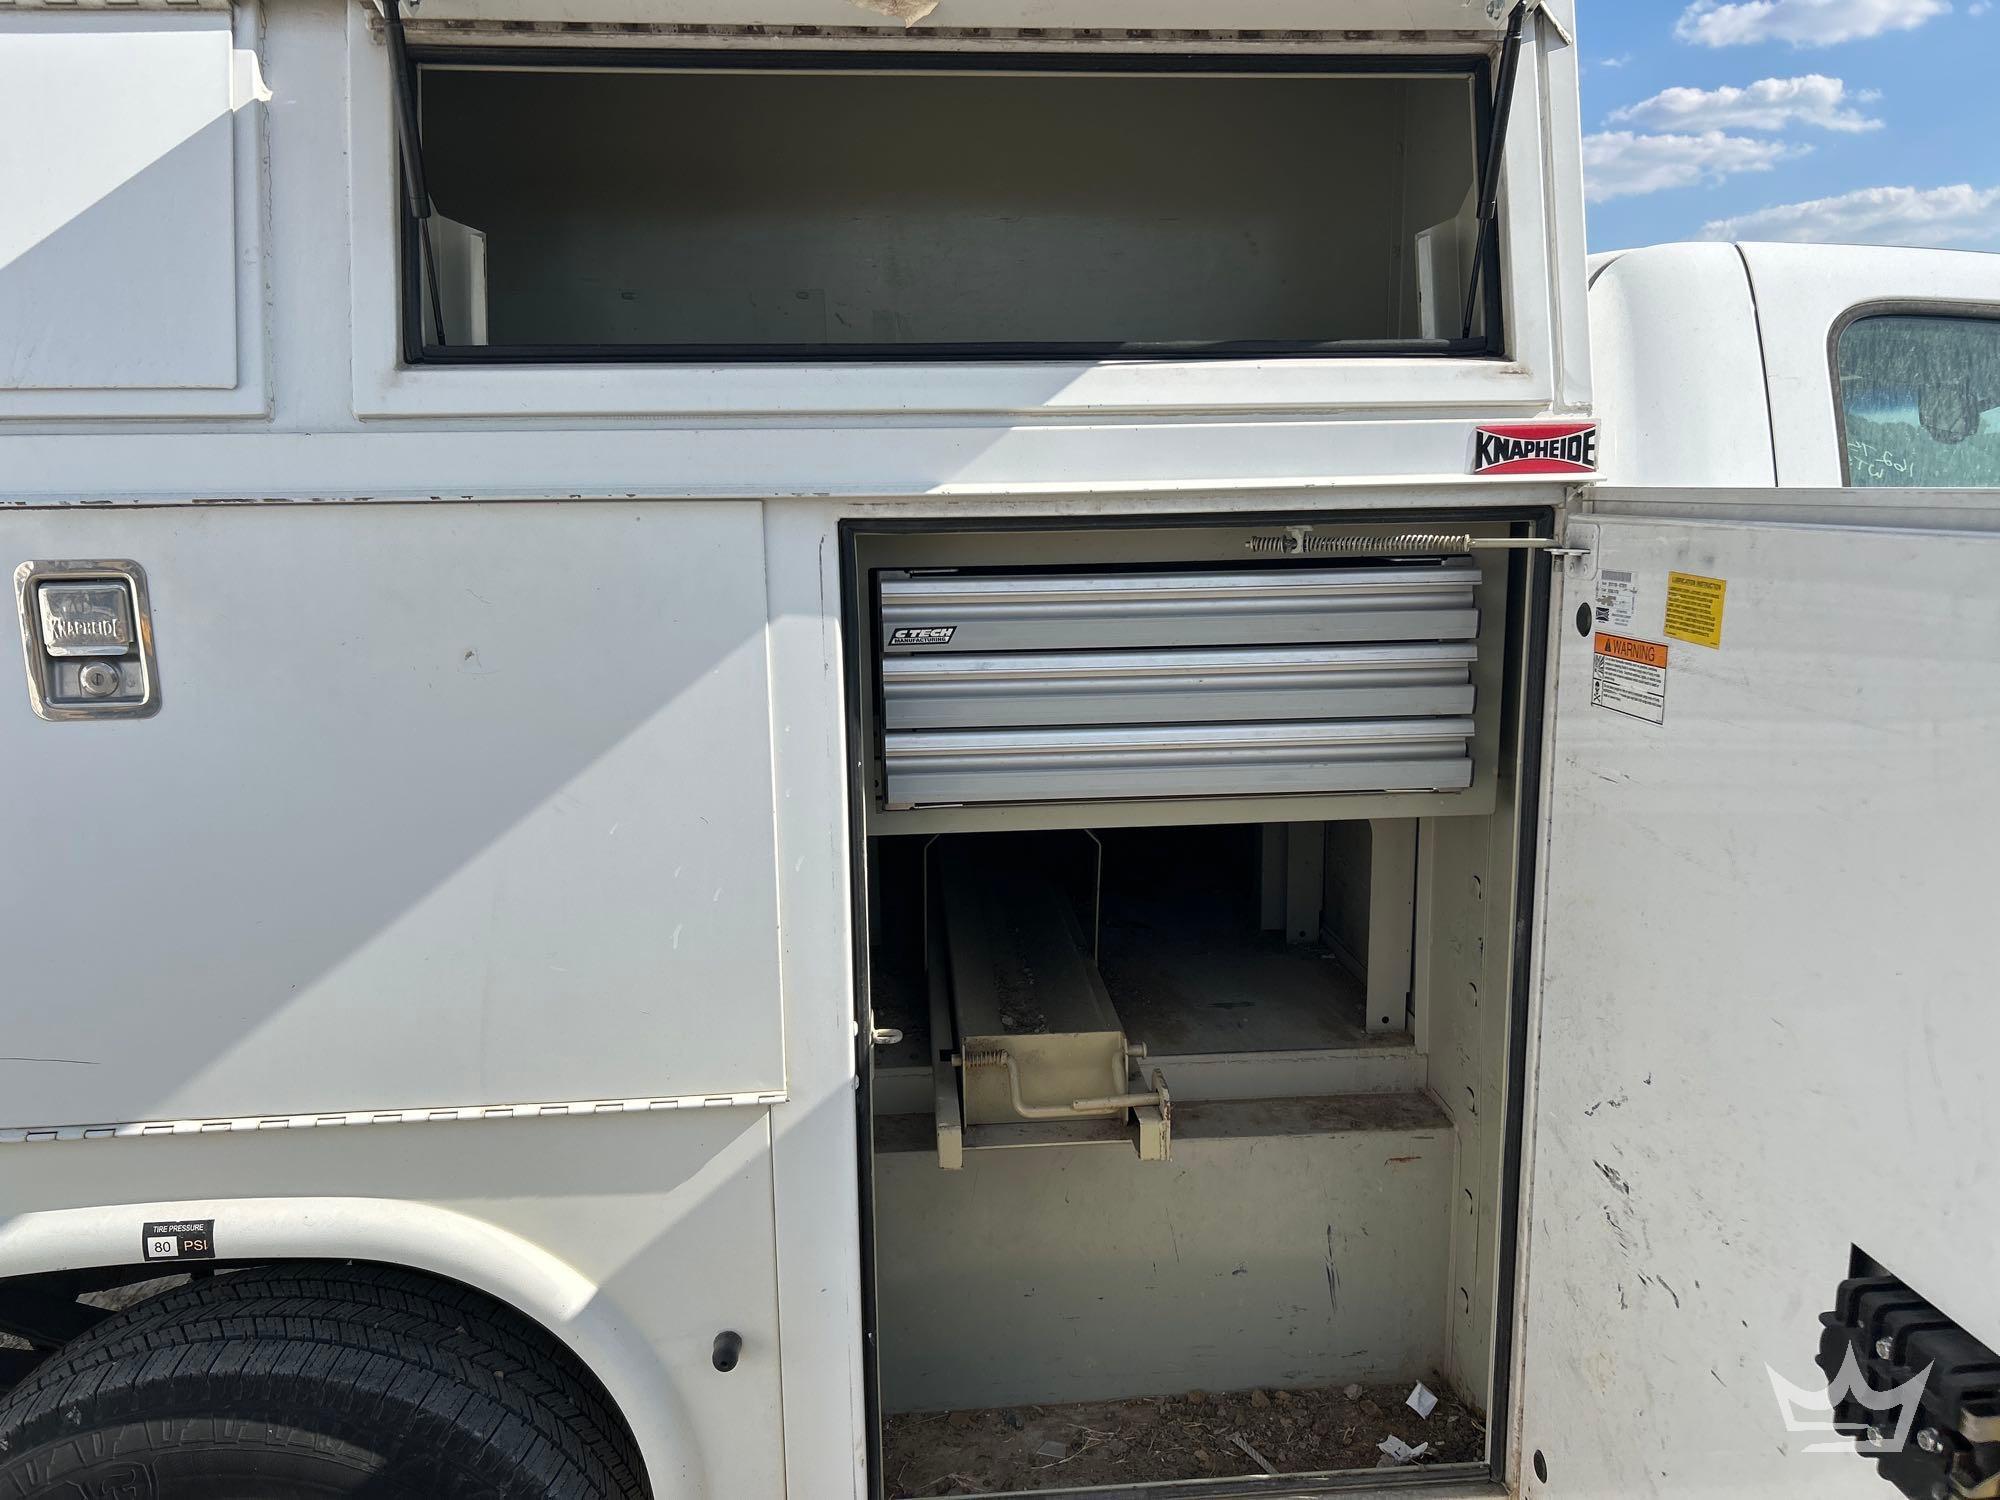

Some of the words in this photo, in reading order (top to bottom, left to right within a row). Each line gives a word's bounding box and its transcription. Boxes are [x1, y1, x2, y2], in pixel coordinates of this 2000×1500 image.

[1476, 429, 1596, 469] KNAPHEIDE
[1613, 641, 1655, 662] WARNING
[153, 1225, 167, 1233] TIRE
[169, 1224, 204, 1232] PRESSURE
[154, 1241, 171, 1253] 80
[184, 1240, 208, 1251] PSI
